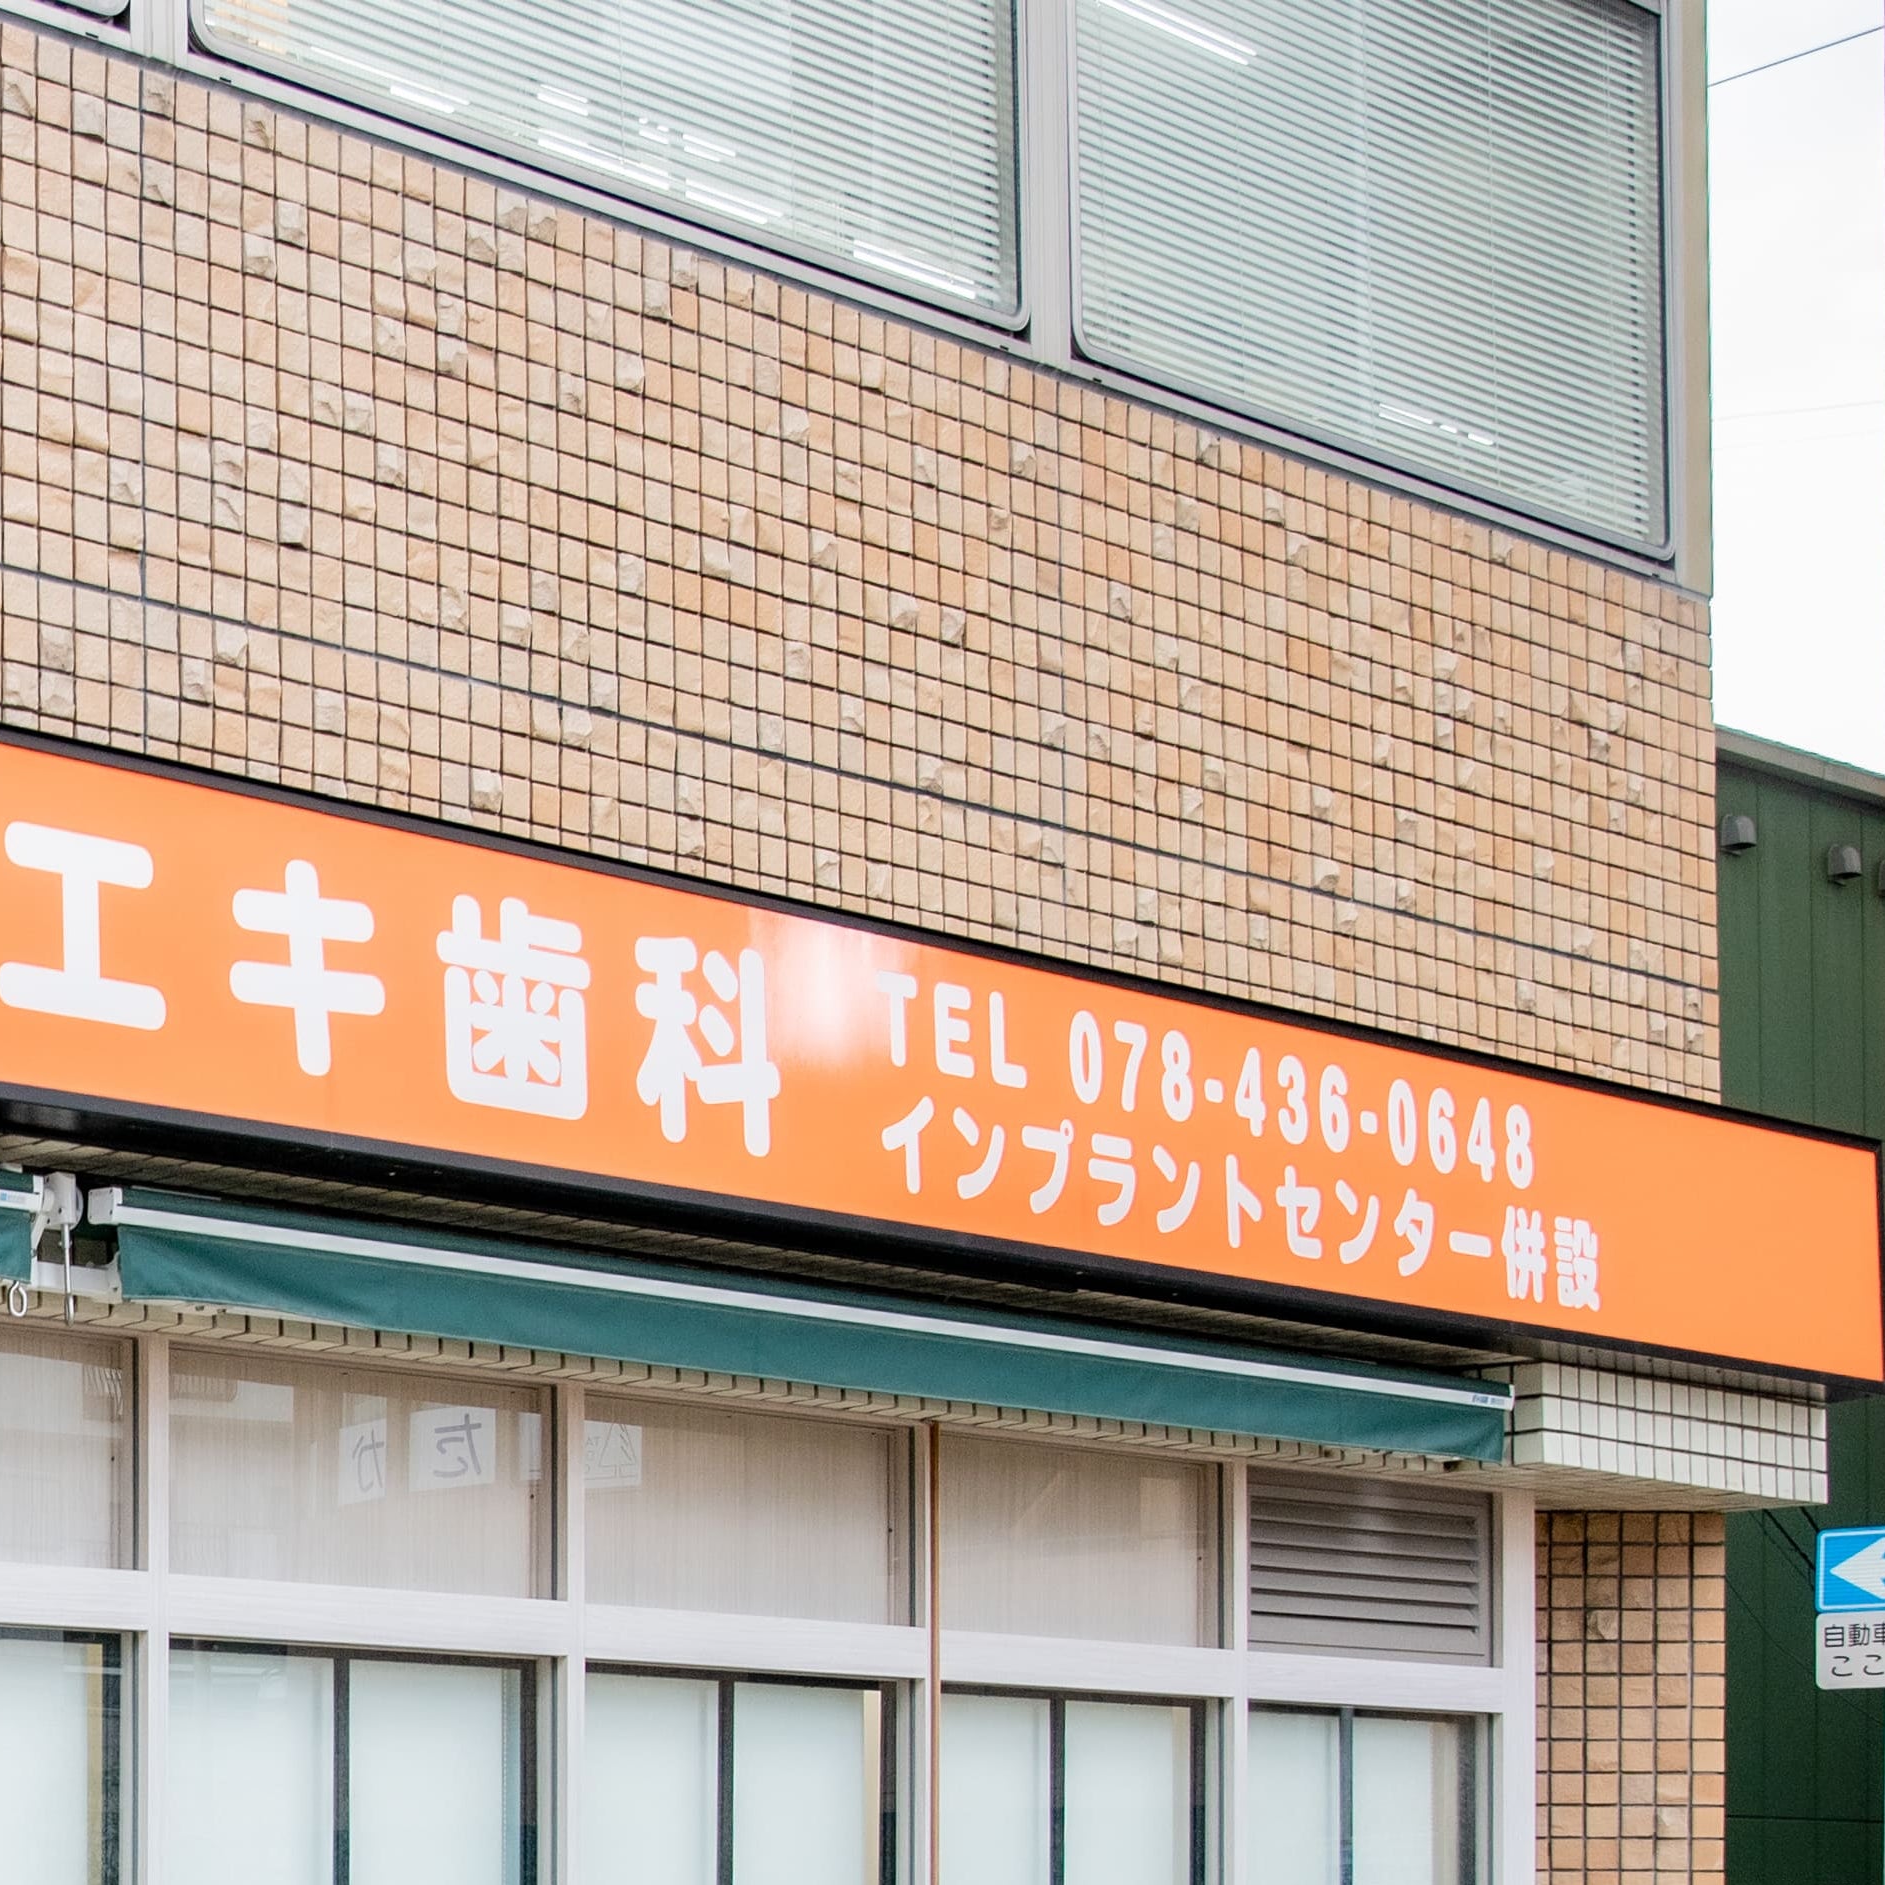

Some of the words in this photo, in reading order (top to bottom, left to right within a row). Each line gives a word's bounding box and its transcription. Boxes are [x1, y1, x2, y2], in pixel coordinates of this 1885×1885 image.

[874, 969, 1029, 1088] TEL
[1068, 1010, 1535, 1189] 078-436-0648
[881, 1095, 1601, 1313] インプラントセンター併設
[1824, 1622, 1885, 1648] 自動車
[1831, 1654, 1885, 1677] ここ
